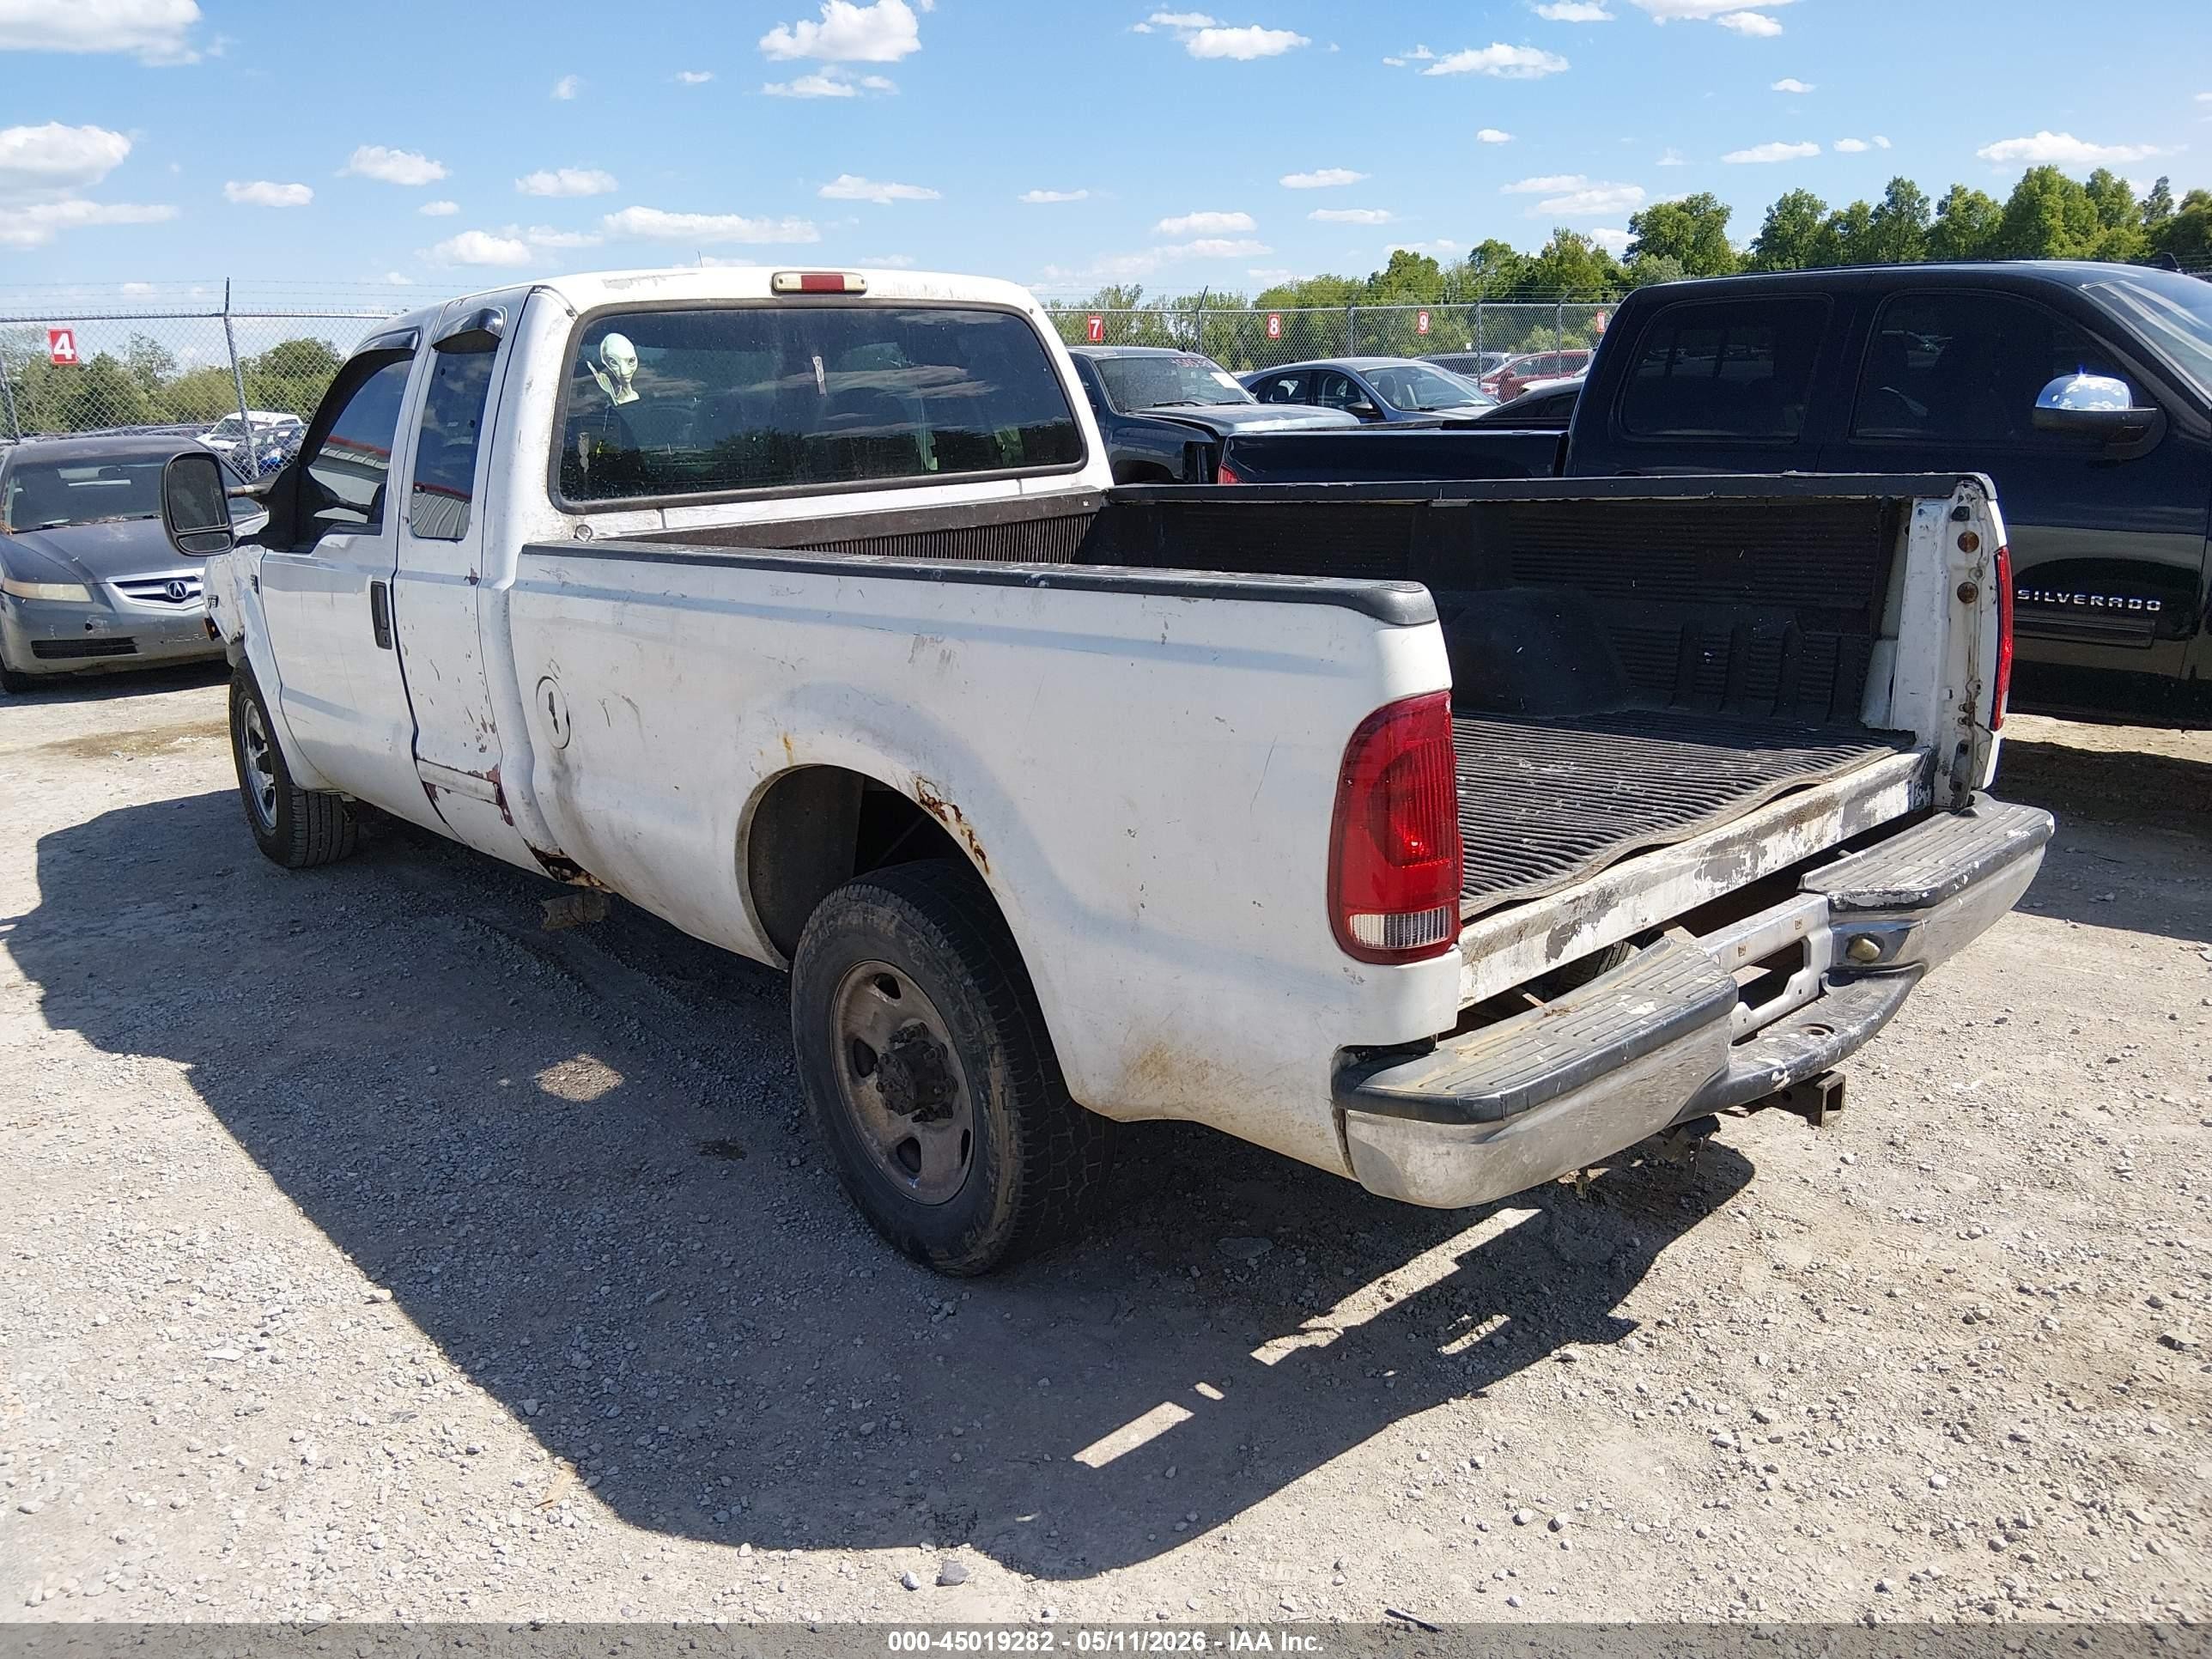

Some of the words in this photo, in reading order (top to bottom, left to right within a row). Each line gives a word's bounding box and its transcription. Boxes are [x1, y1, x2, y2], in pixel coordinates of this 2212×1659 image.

[1090, 319, 1101, 338] 7
[1270, 317, 1279, 336] 8
[1419, 314, 1427, 331] 9
[53, 333, 75, 360] 4
[2017, 589, 2161, 611] SILVERADO
